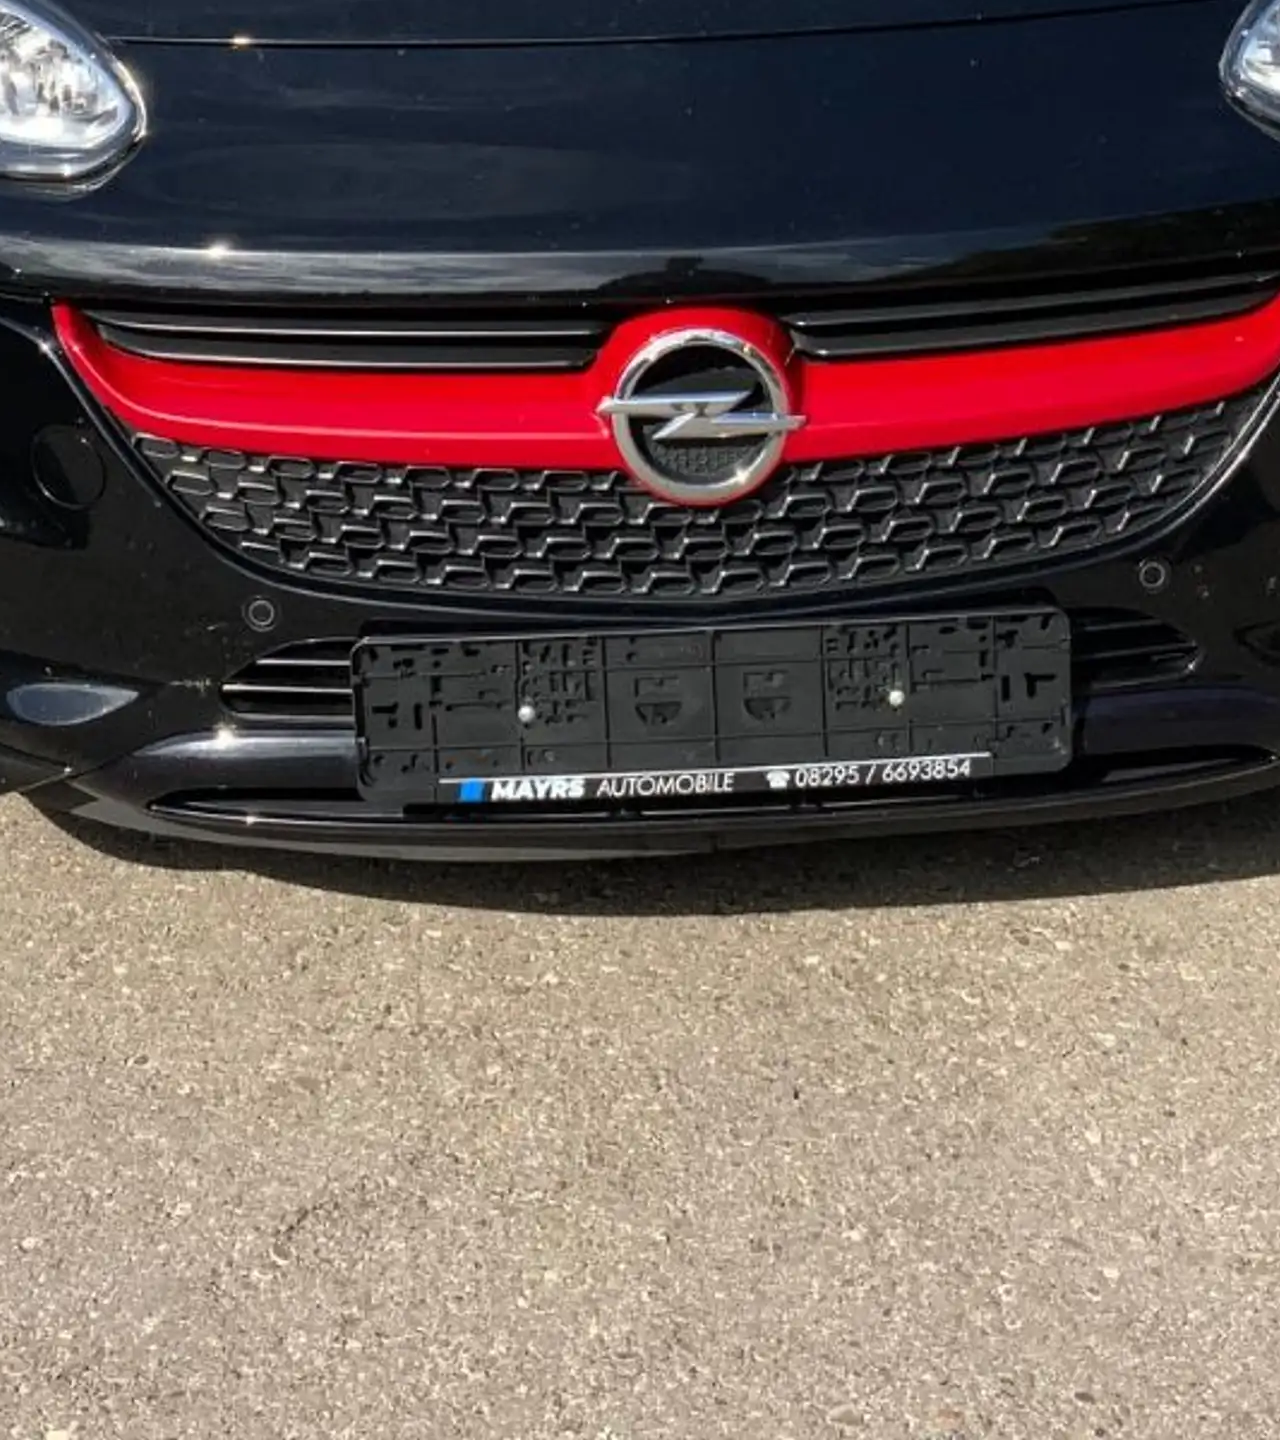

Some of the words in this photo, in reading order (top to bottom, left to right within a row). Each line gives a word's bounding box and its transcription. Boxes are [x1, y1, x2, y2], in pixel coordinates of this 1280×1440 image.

[490, 777, 586, 802] MAYRS
[596, 771, 736, 798] AUTOMOBILE
[795, 765, 860, 789] 08295
[882, 758, 972, 784] 6693854
